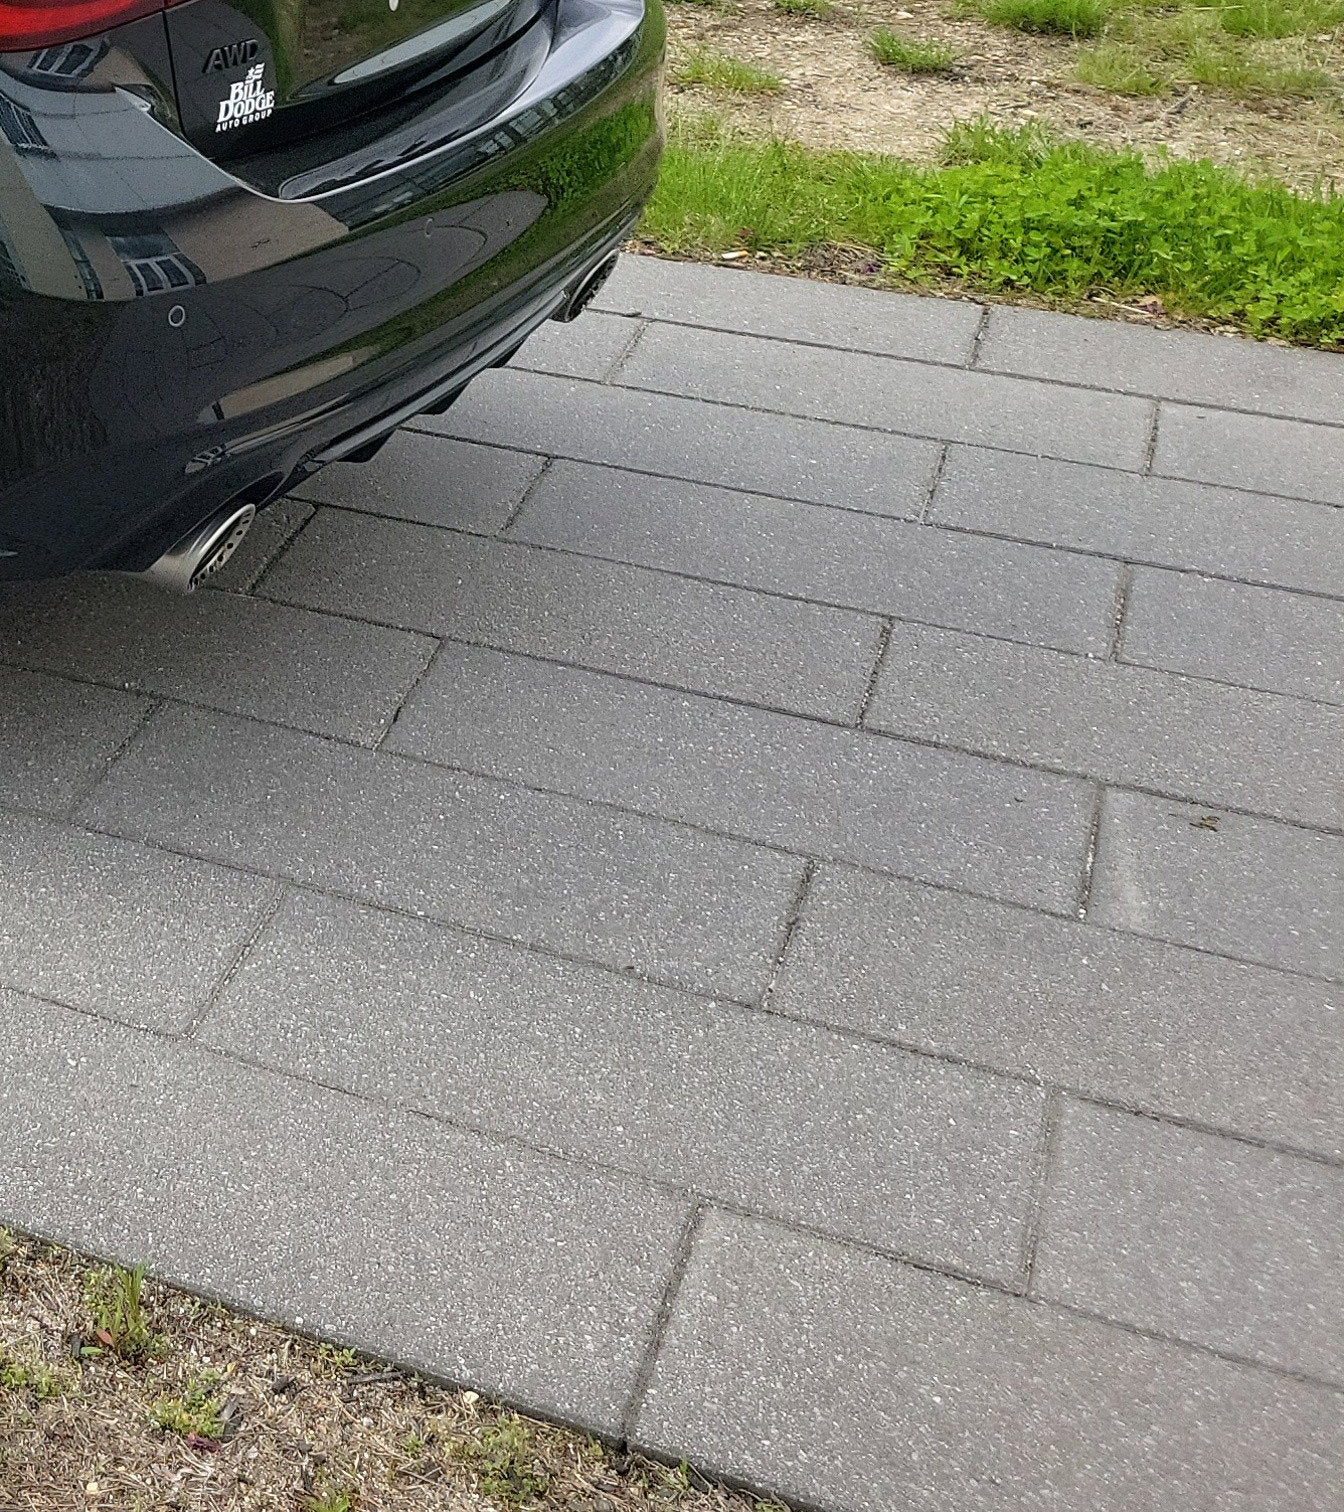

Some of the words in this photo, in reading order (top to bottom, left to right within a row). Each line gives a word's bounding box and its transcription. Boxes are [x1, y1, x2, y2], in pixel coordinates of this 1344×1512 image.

[201, 37, 259, 73] AWD
[230, 79, 265, 103] BILL
[215, 118, 240, 133] AUTO
[241, 108, 273, 125] GROUP
[216, 90, 275, 123] DODGE
